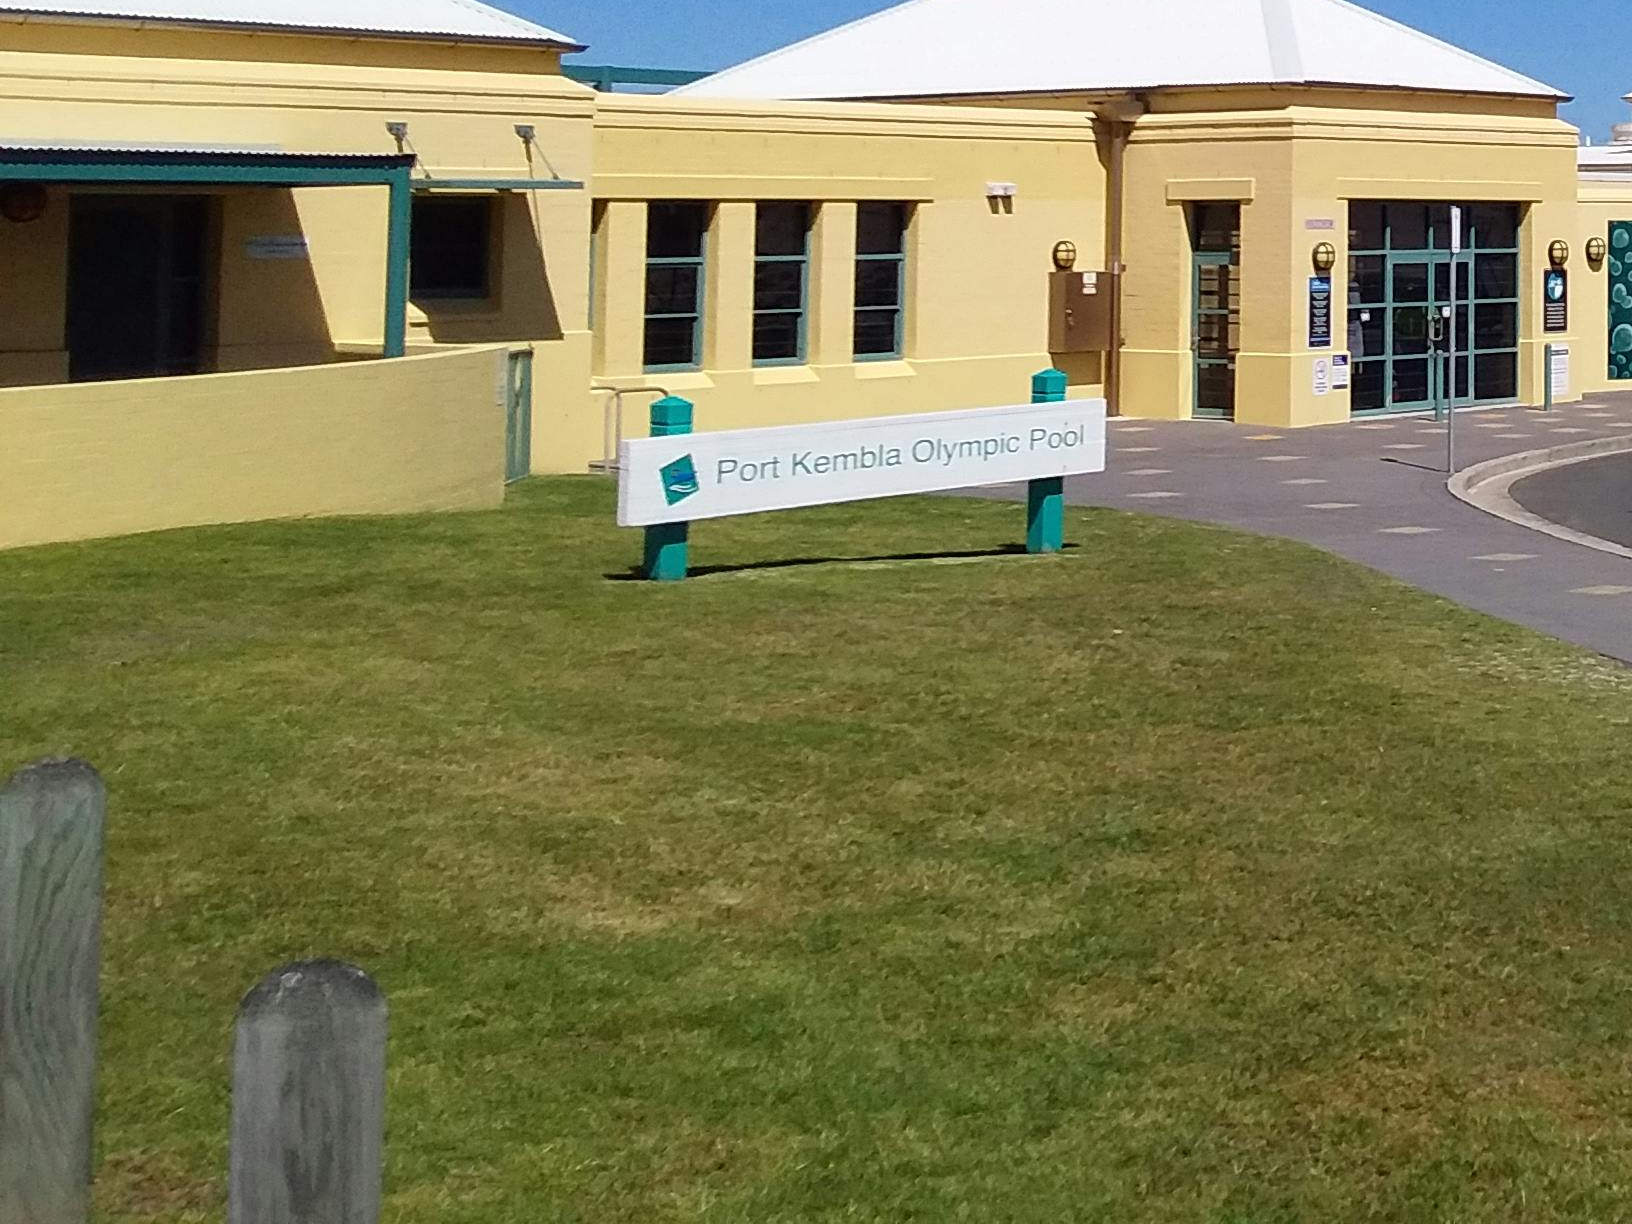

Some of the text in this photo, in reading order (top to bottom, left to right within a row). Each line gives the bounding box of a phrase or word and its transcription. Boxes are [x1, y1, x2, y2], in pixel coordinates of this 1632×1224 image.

[716, 424, 1085, 484] Port Kembla Olympic Pool
